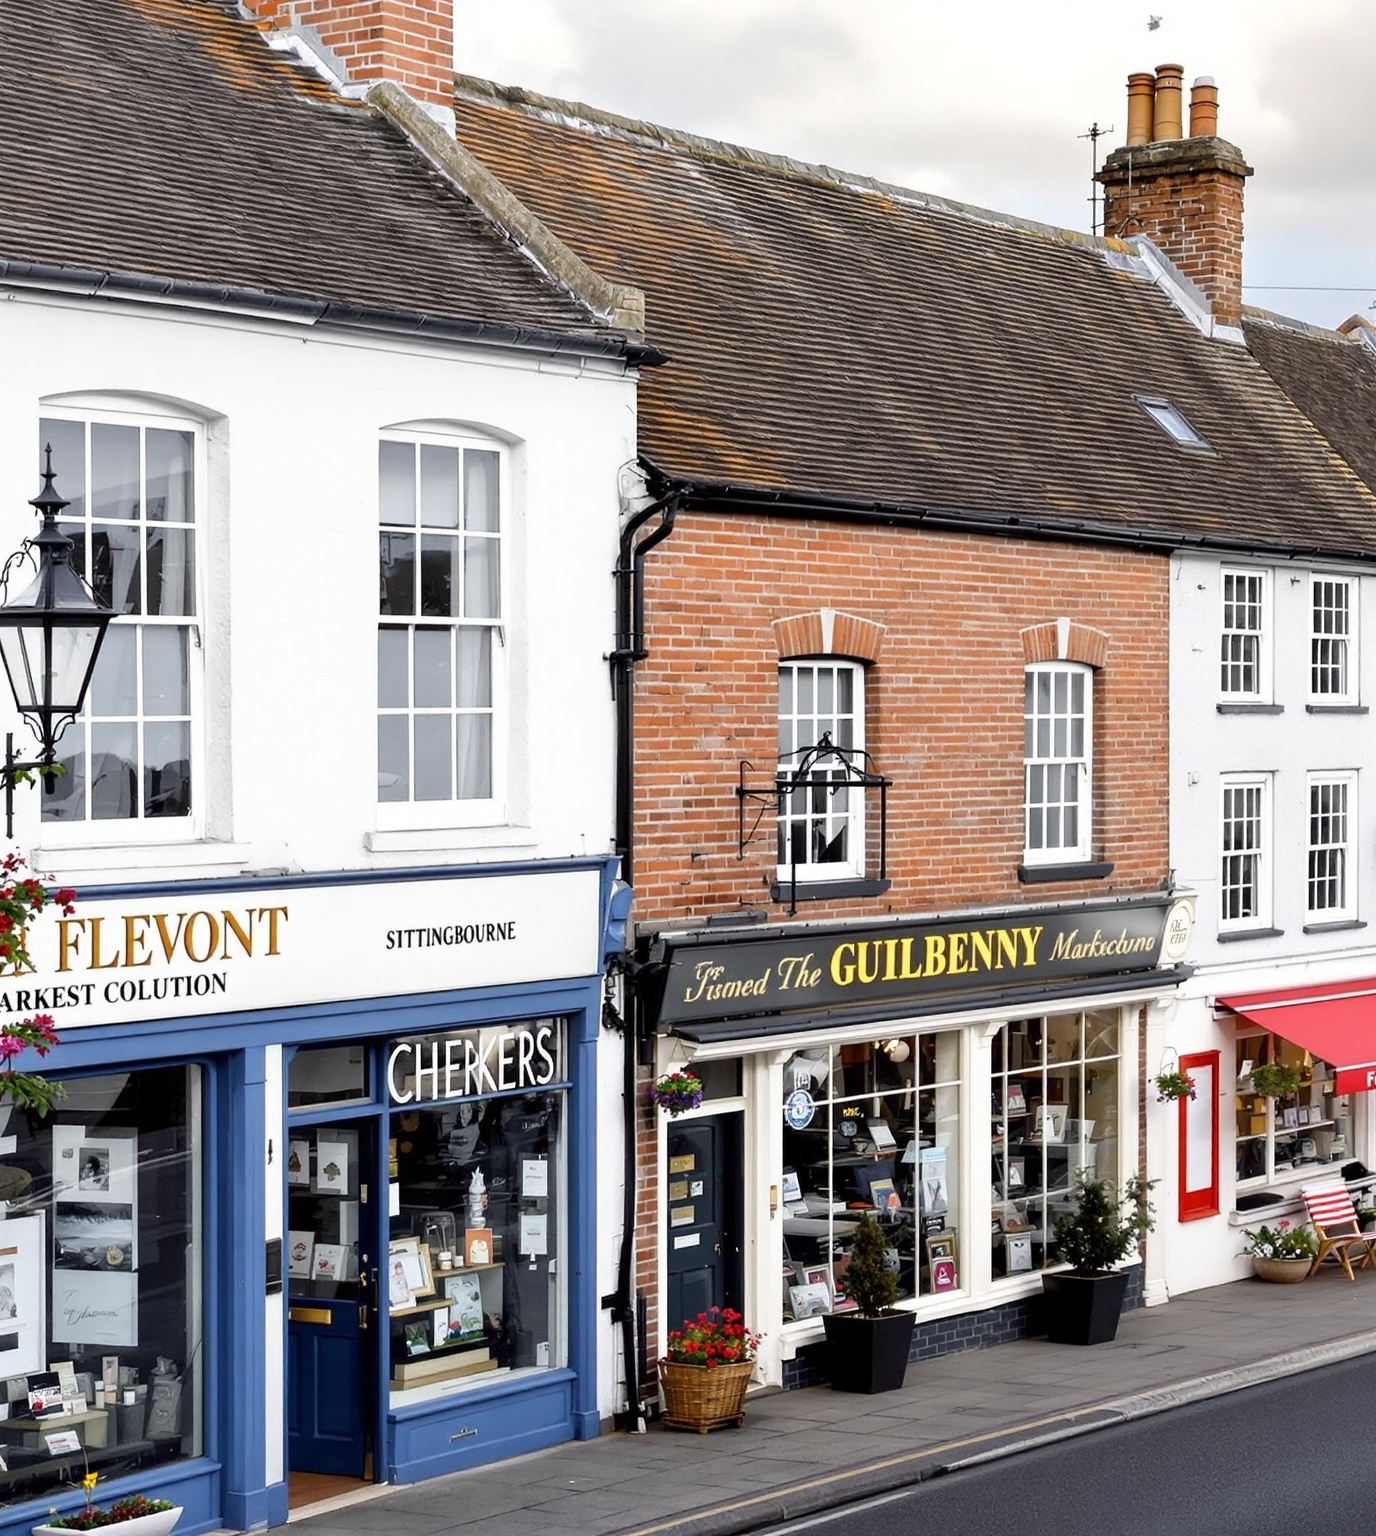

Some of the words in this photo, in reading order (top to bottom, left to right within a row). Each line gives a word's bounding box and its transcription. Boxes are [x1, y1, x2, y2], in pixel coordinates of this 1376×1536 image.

[54, 906, 289, 973] FLEVONT
[386, 921, 516, 949] SITTINGBOURNE
[777, 952, 823, 990] The
[830, 926, 1043, 987] GUILBENNY
[103, 972, 228, 1004] COLUTION
